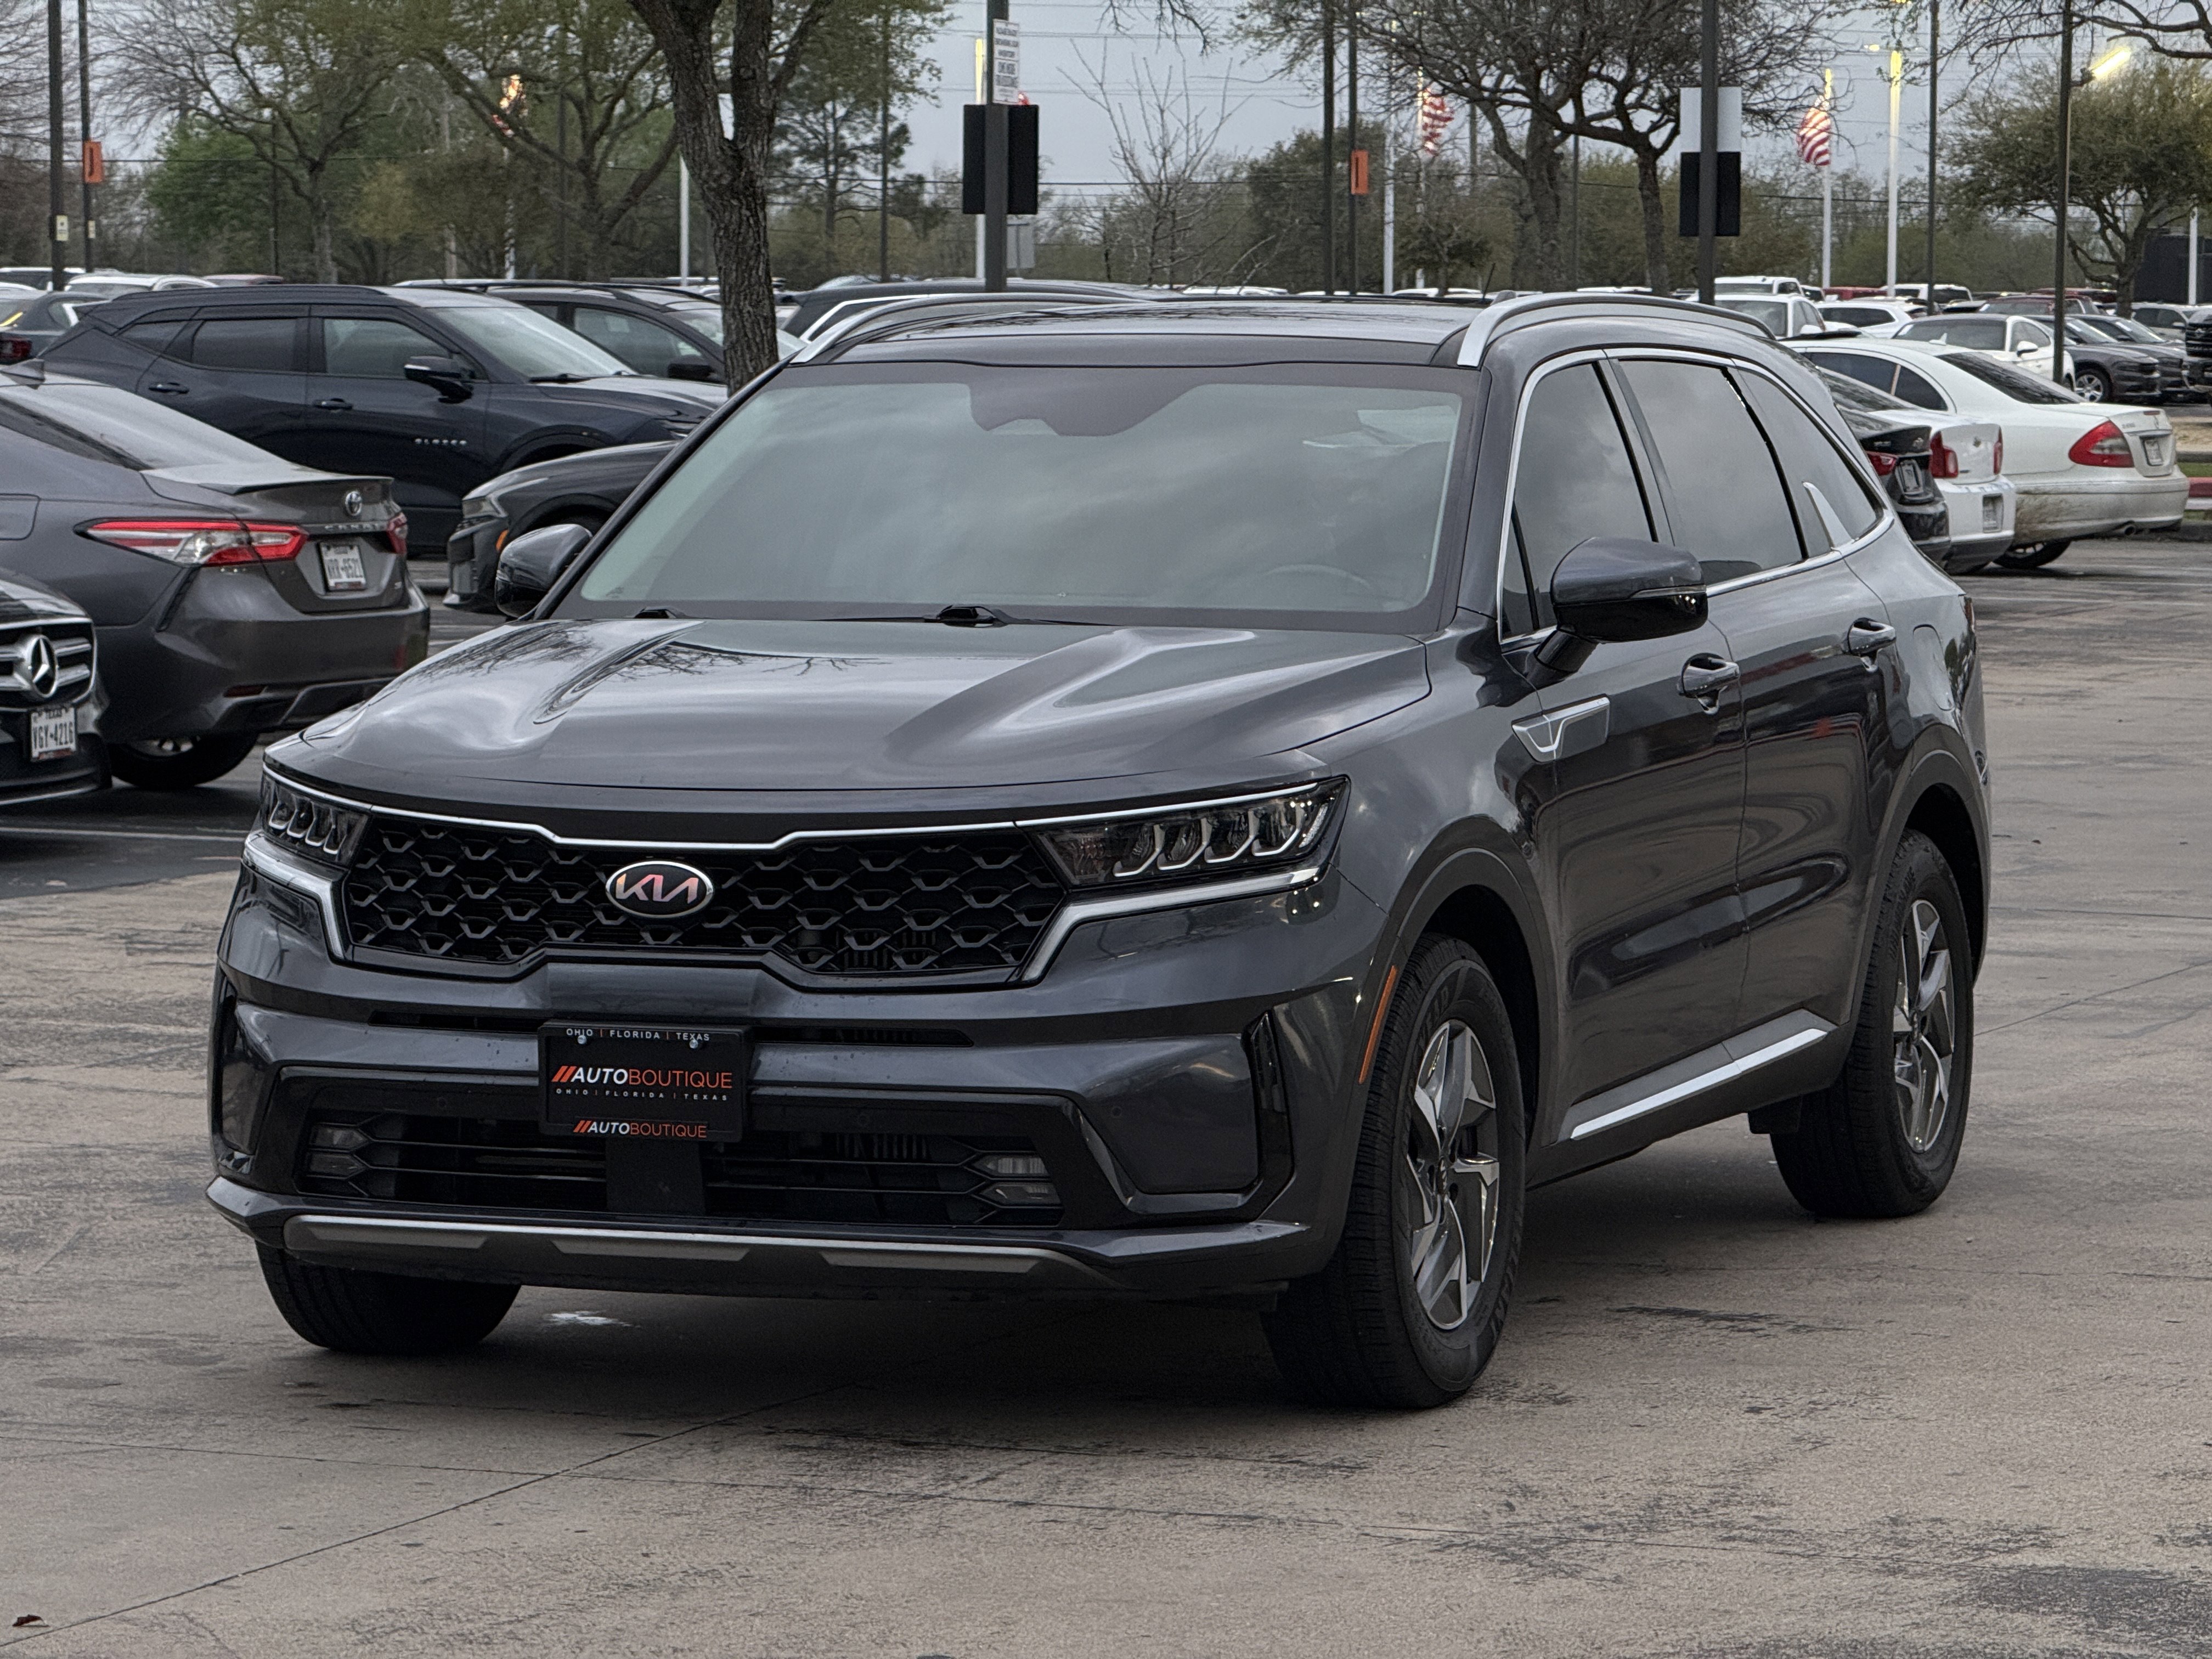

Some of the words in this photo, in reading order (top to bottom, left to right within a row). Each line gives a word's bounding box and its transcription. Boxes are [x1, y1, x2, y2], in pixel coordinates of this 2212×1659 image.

[566, 1028, 594, 1037] OHIO
[609, 1029, 660, 1040] FLORIDA
[676, 1032, 710, 1041] TEXAS
[605, 1090, 664, 1098] FLORIDA
[684, 1093, 727, 1101] TEXAS
